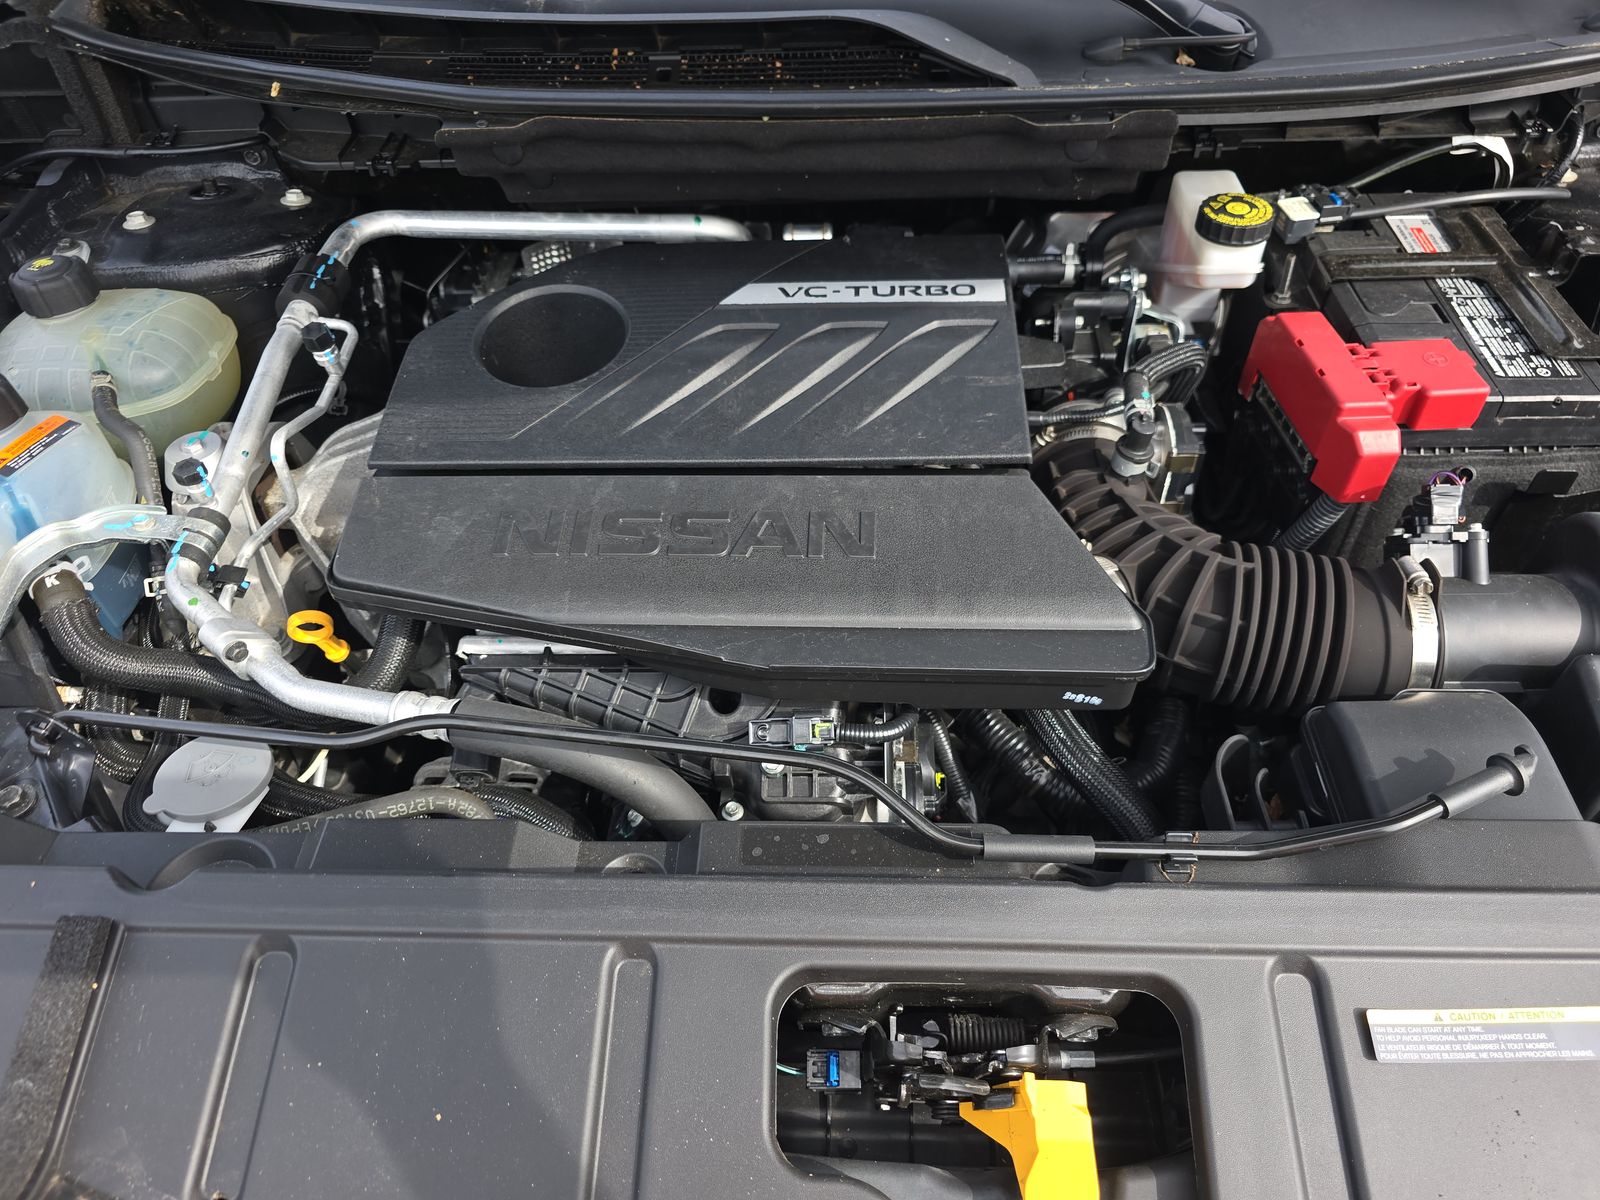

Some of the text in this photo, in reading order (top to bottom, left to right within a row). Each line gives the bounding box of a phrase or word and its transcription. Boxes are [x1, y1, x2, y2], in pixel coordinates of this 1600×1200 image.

[778, 284, 976, 299] VC-TURBO
[492, 509, 877, 559] NISSAN
[44, 574, 60, 588] K
[1449, 1012, 1496, 1021] CAUTION
[1508, 1011, 1565, 1020] ATTENTION
